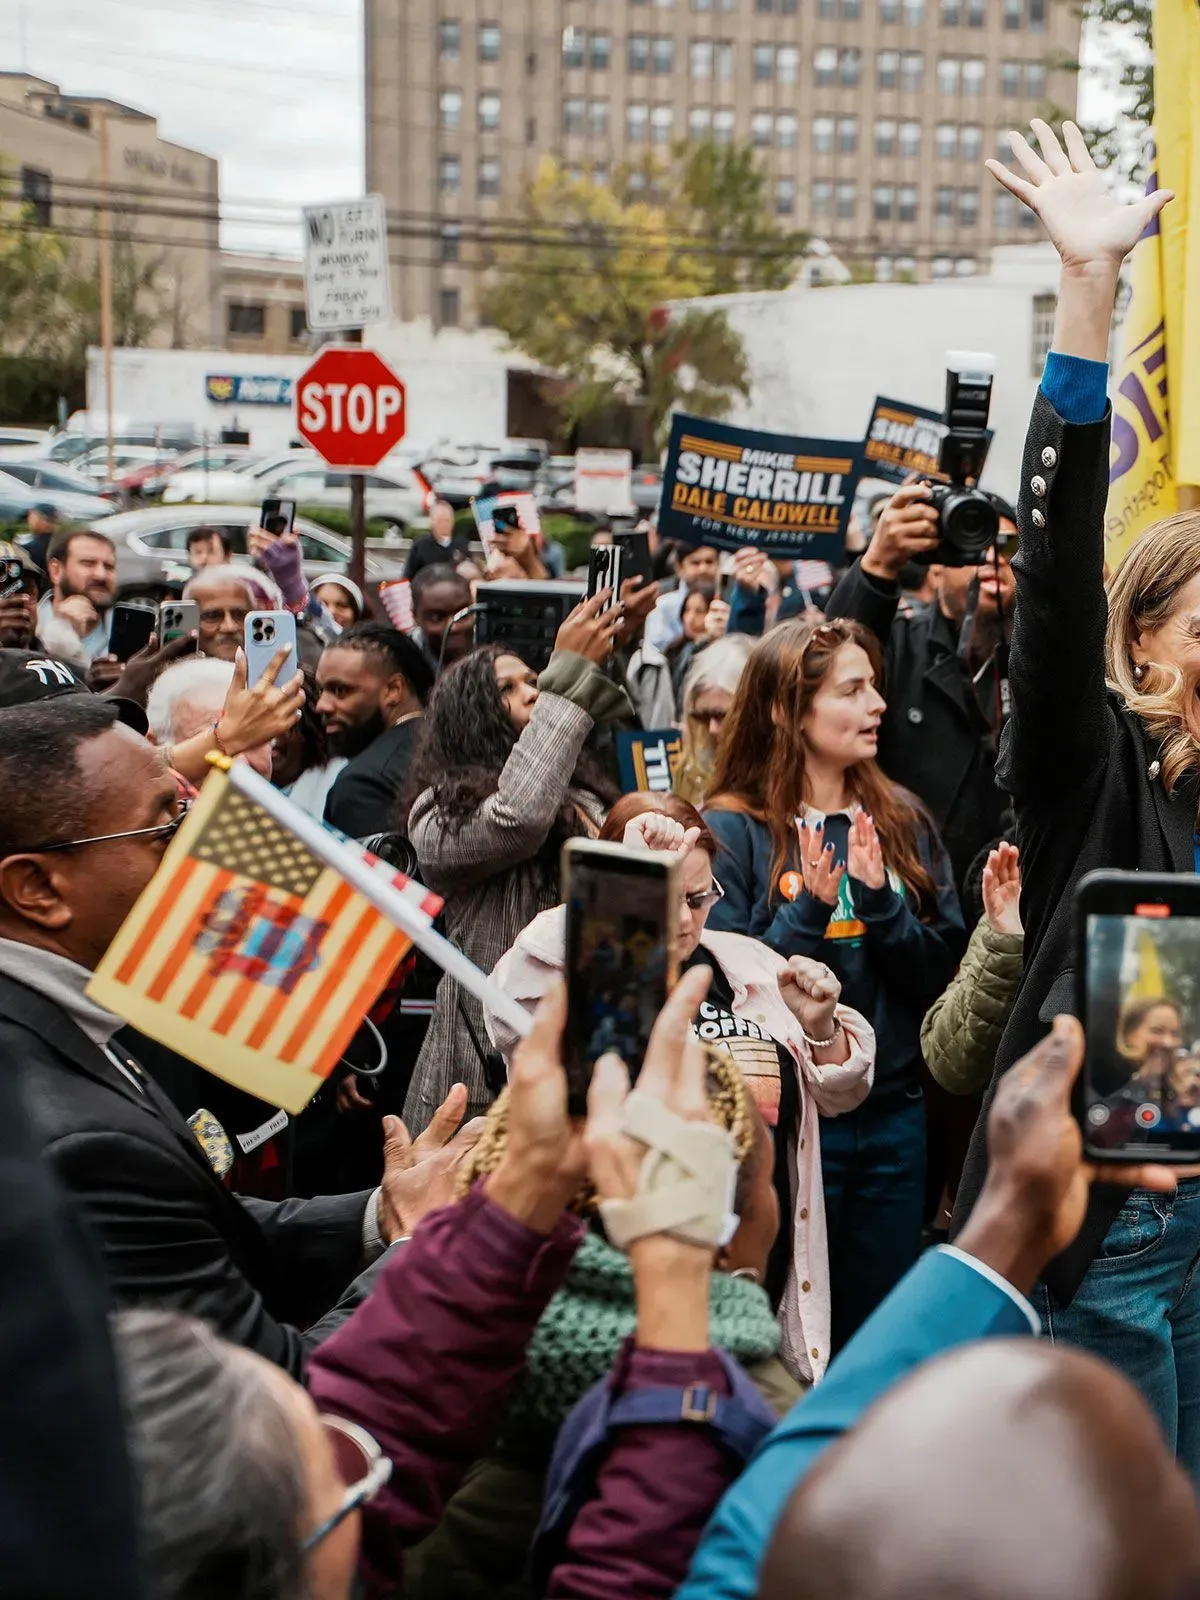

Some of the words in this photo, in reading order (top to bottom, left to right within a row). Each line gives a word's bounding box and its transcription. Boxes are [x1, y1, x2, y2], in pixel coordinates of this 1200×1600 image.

[301, 381, 401, 435] STOP
[675, 451, 846, 504] SHERRILL
[742, 447, 796, 469] MIKIE
[673, 482, 727, 514] DALE
[733, 496, 841, 526] CALDWELL
[692, 516, 722, 532] FOR
[726, 522, 759, 541] NEW
[765, 531, 816, 544] JERSEY
